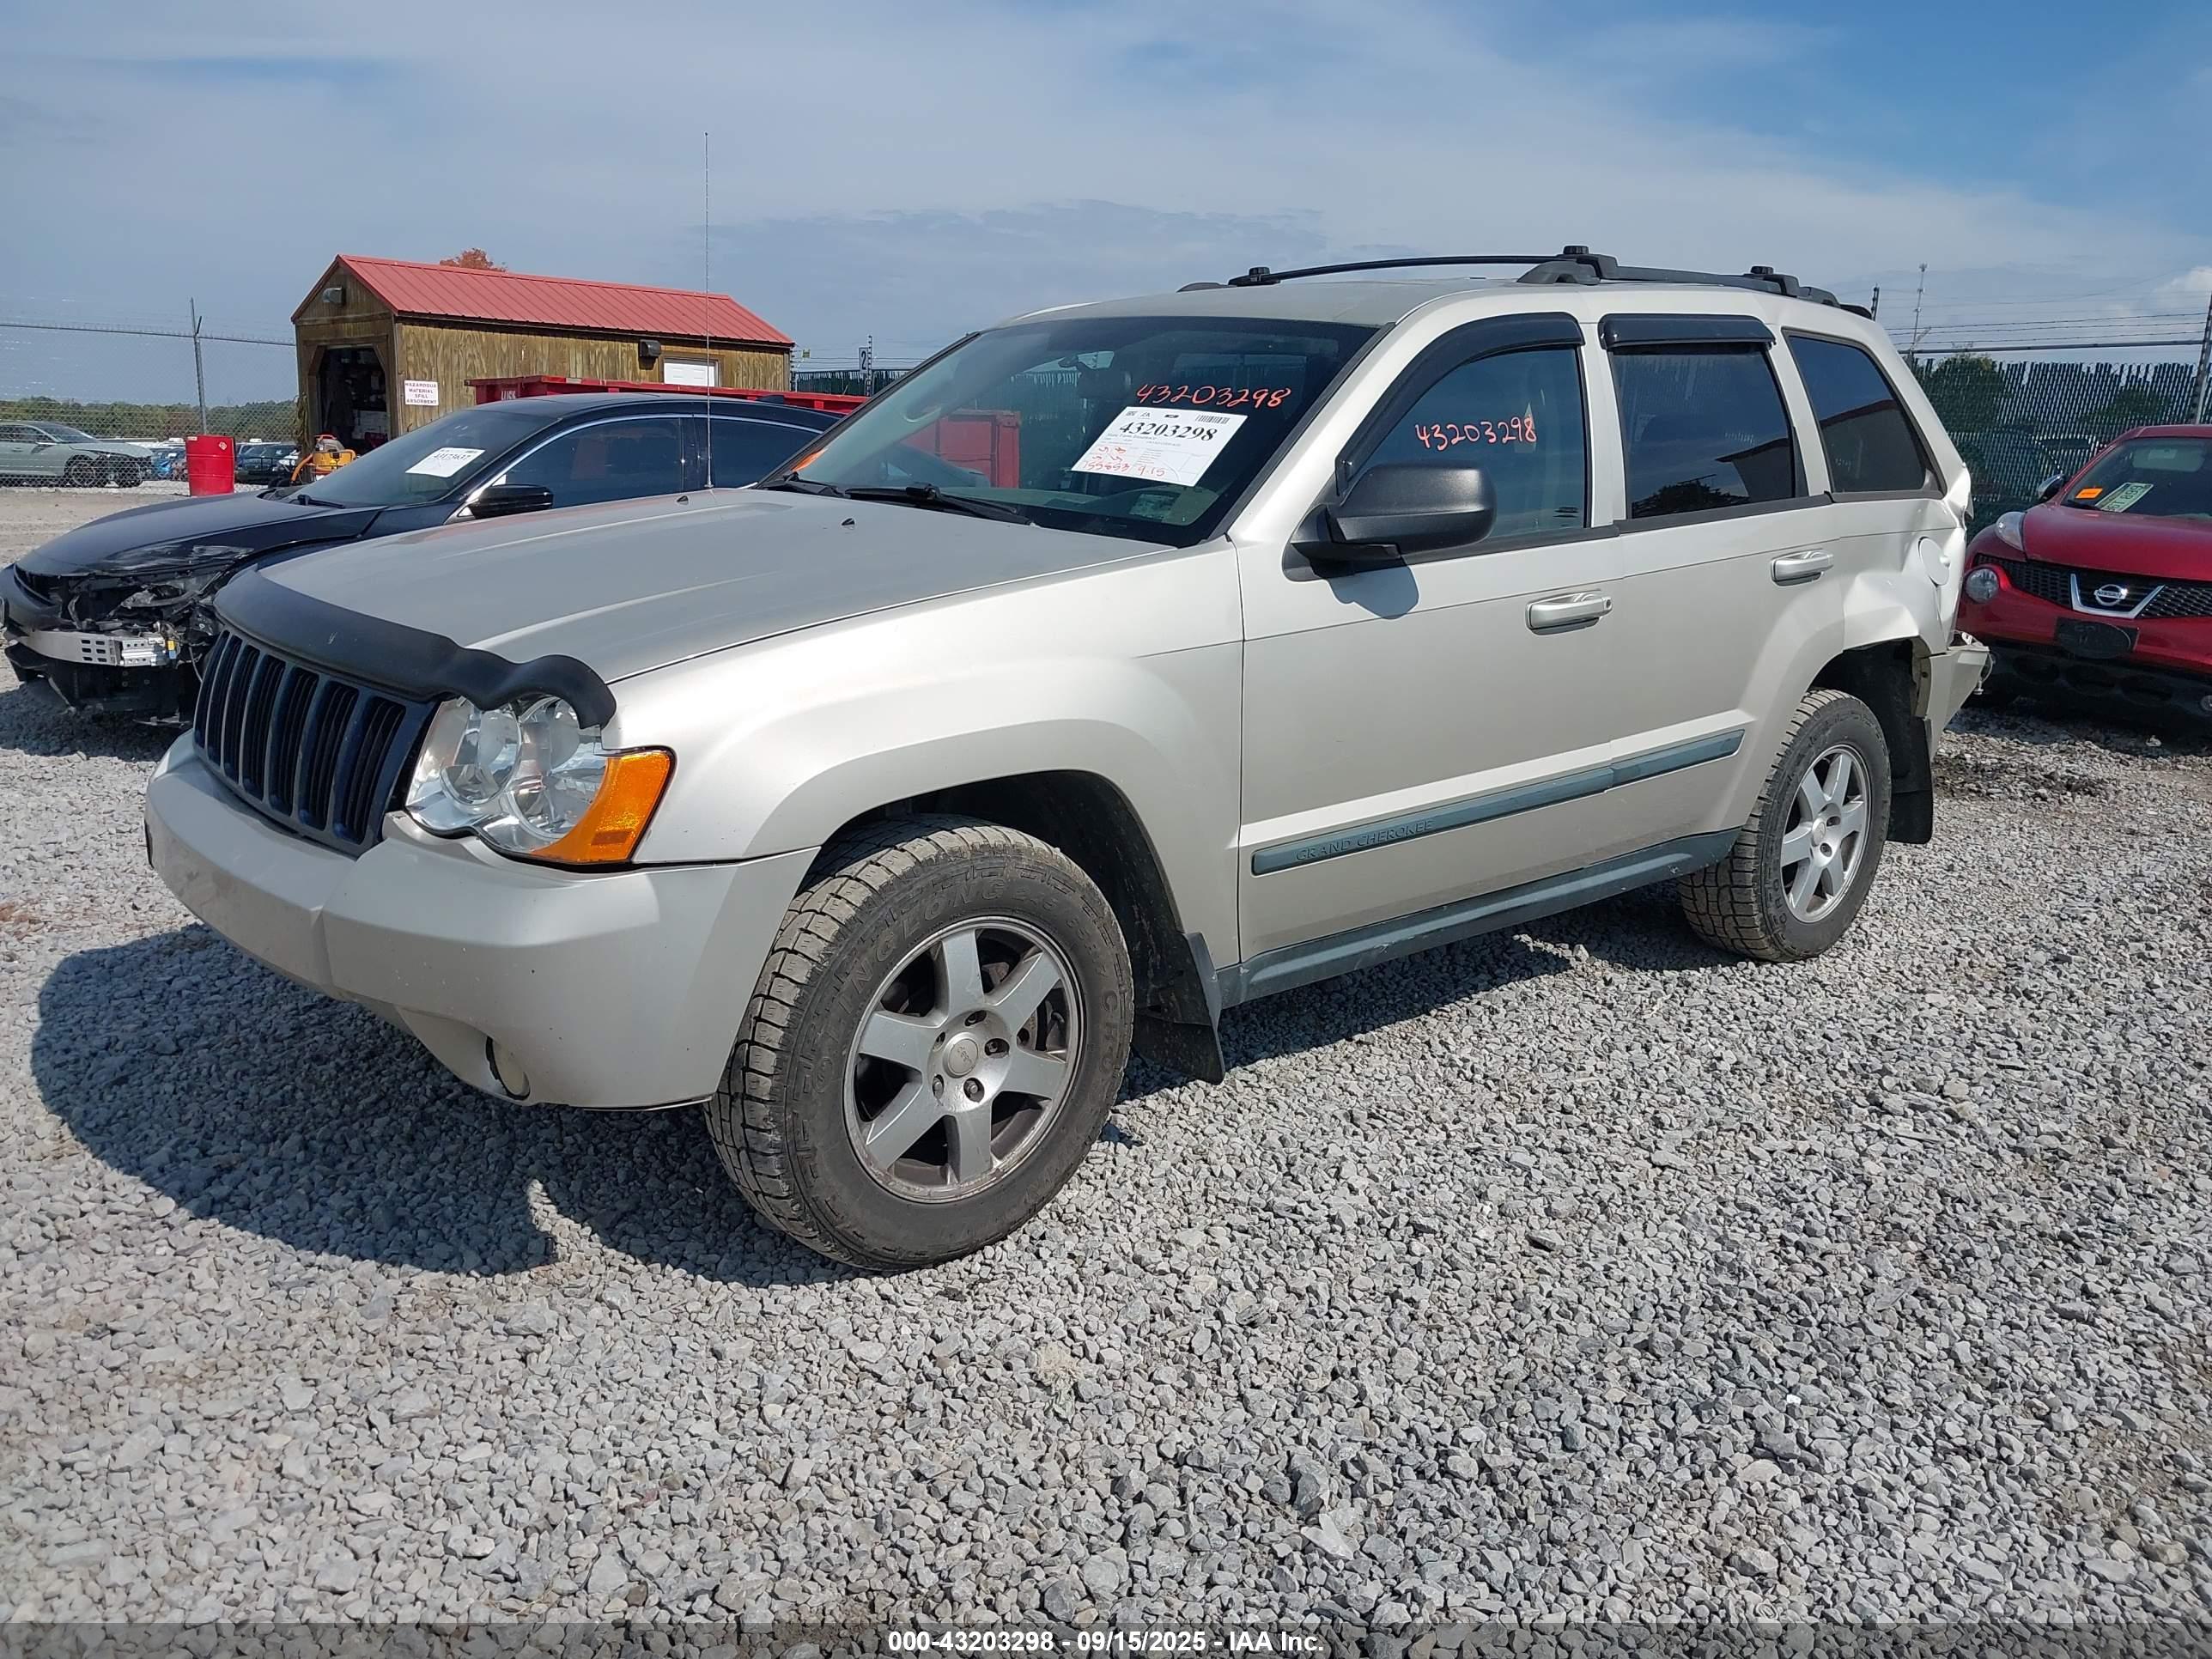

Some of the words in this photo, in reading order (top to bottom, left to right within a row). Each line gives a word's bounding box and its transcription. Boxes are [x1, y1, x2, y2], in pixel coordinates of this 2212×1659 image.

[860, 350, 866, 370] 2
[1136, 384, 1292, 409] 43203298
[1119, 422, 1218, 441] 43203298
[1415, 414, 1537, 451] 43203298
[1295, 839, 1352, 861] GRAND
[1357, 819, 1435, 848] CHEROKEE
